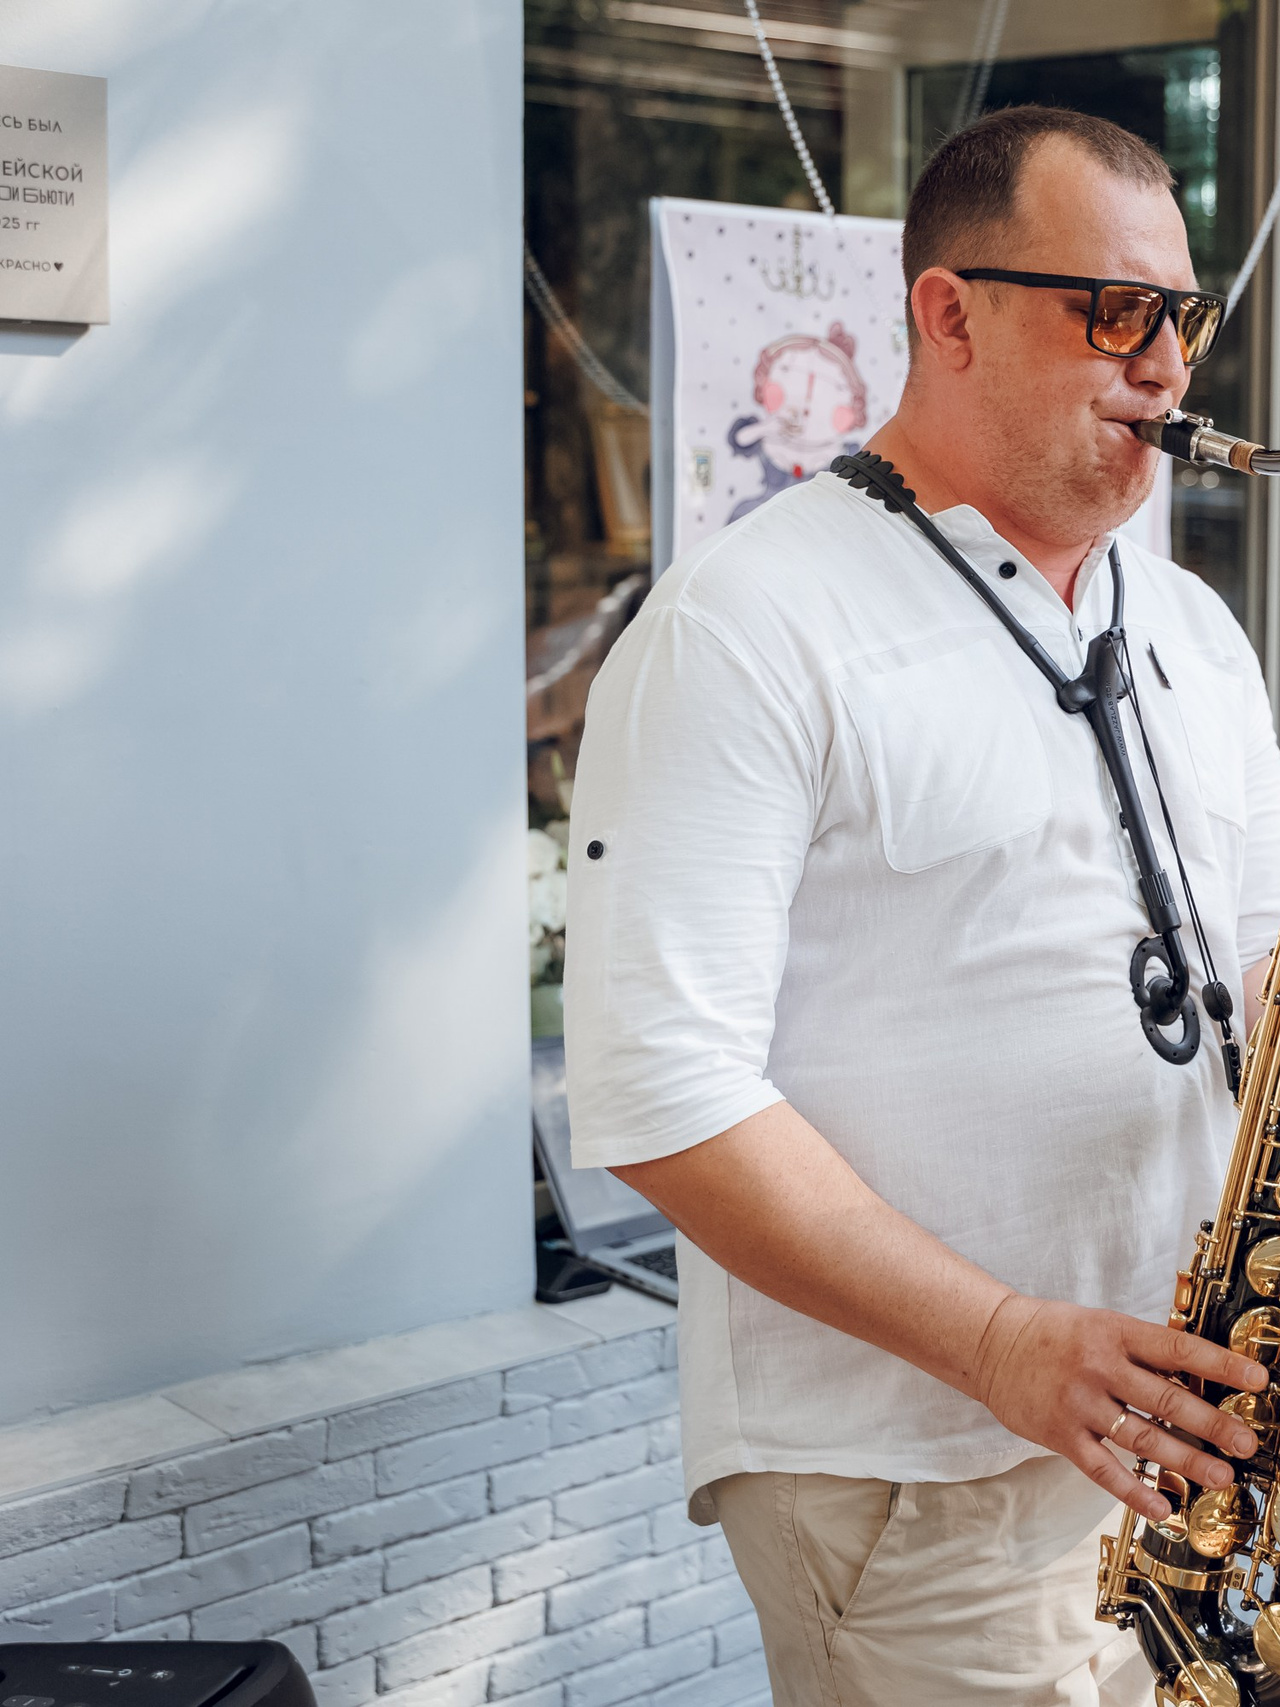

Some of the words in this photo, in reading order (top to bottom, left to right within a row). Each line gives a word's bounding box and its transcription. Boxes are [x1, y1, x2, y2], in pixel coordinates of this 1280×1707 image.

[0, 115, 22, 129] СЬ
[28, 118, 62, 133] БЫЛ
[2, 157, 83, 183] ЕЙСКОЙ
[23, 187, 75, 206] БЬЮТИ
[0, 216, 21, 229] 25
